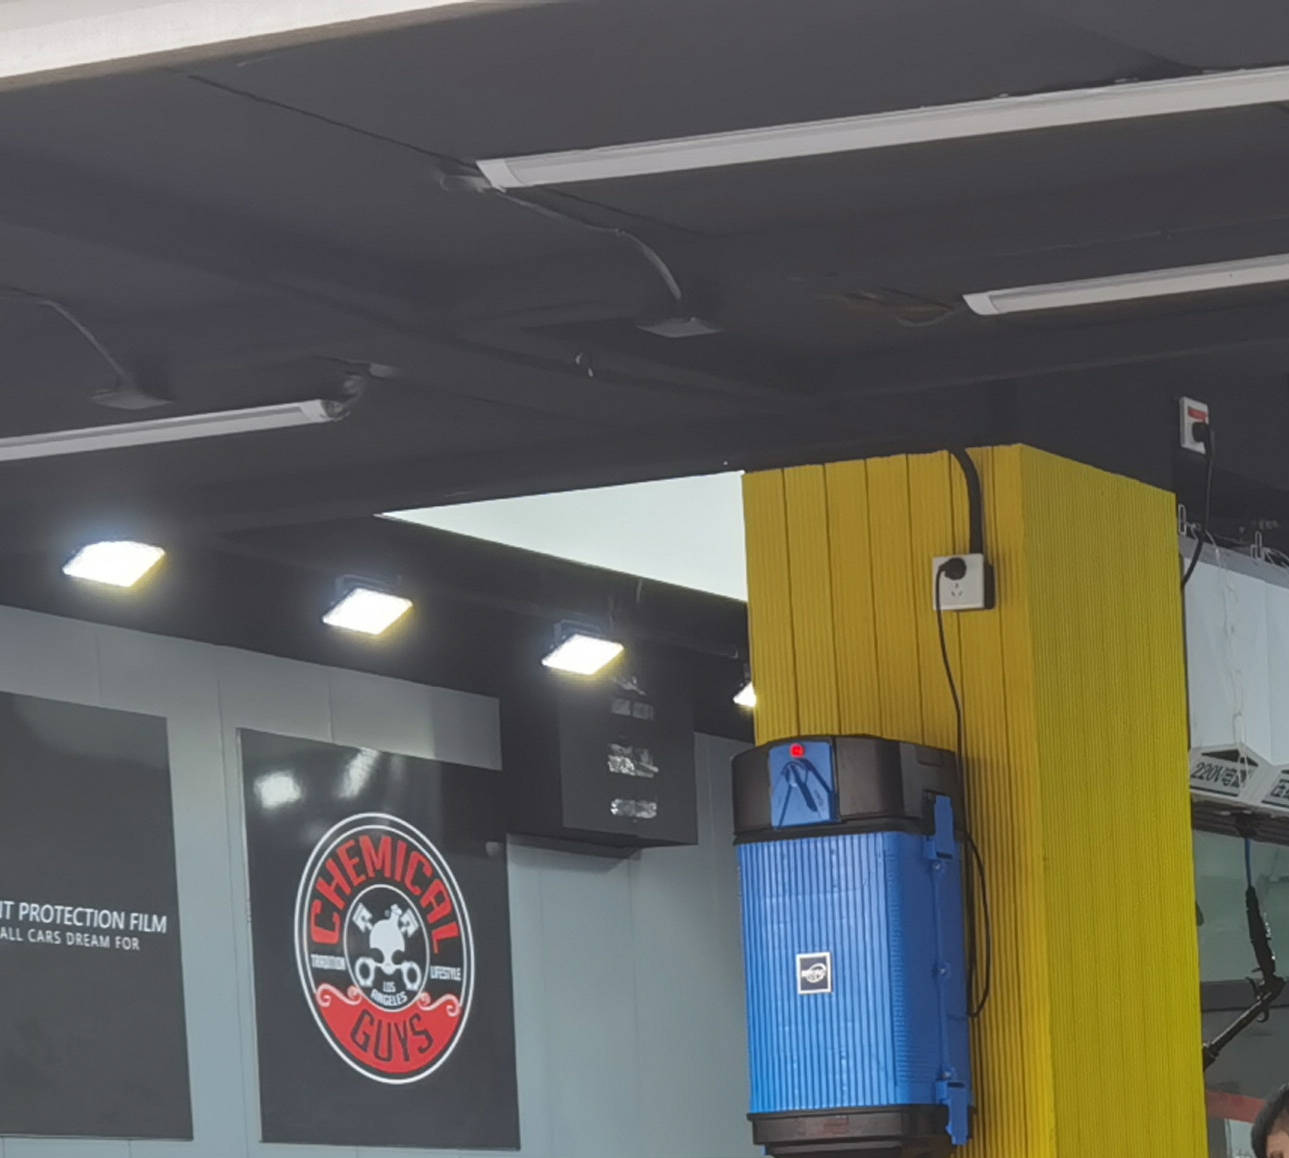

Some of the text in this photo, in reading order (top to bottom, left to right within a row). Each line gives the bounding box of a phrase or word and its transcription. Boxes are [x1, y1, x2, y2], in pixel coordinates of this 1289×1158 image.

[310, 835, 459, 954] CHEMICAL
[0, 901, 168, 934] T PROTECTION FILM
[0, 927, 140, 951] ALL CARS DREAM FOR
[430, 965, 462, 981] LIFESTYLE
[351, 1009, 434, 1062] GUYS
